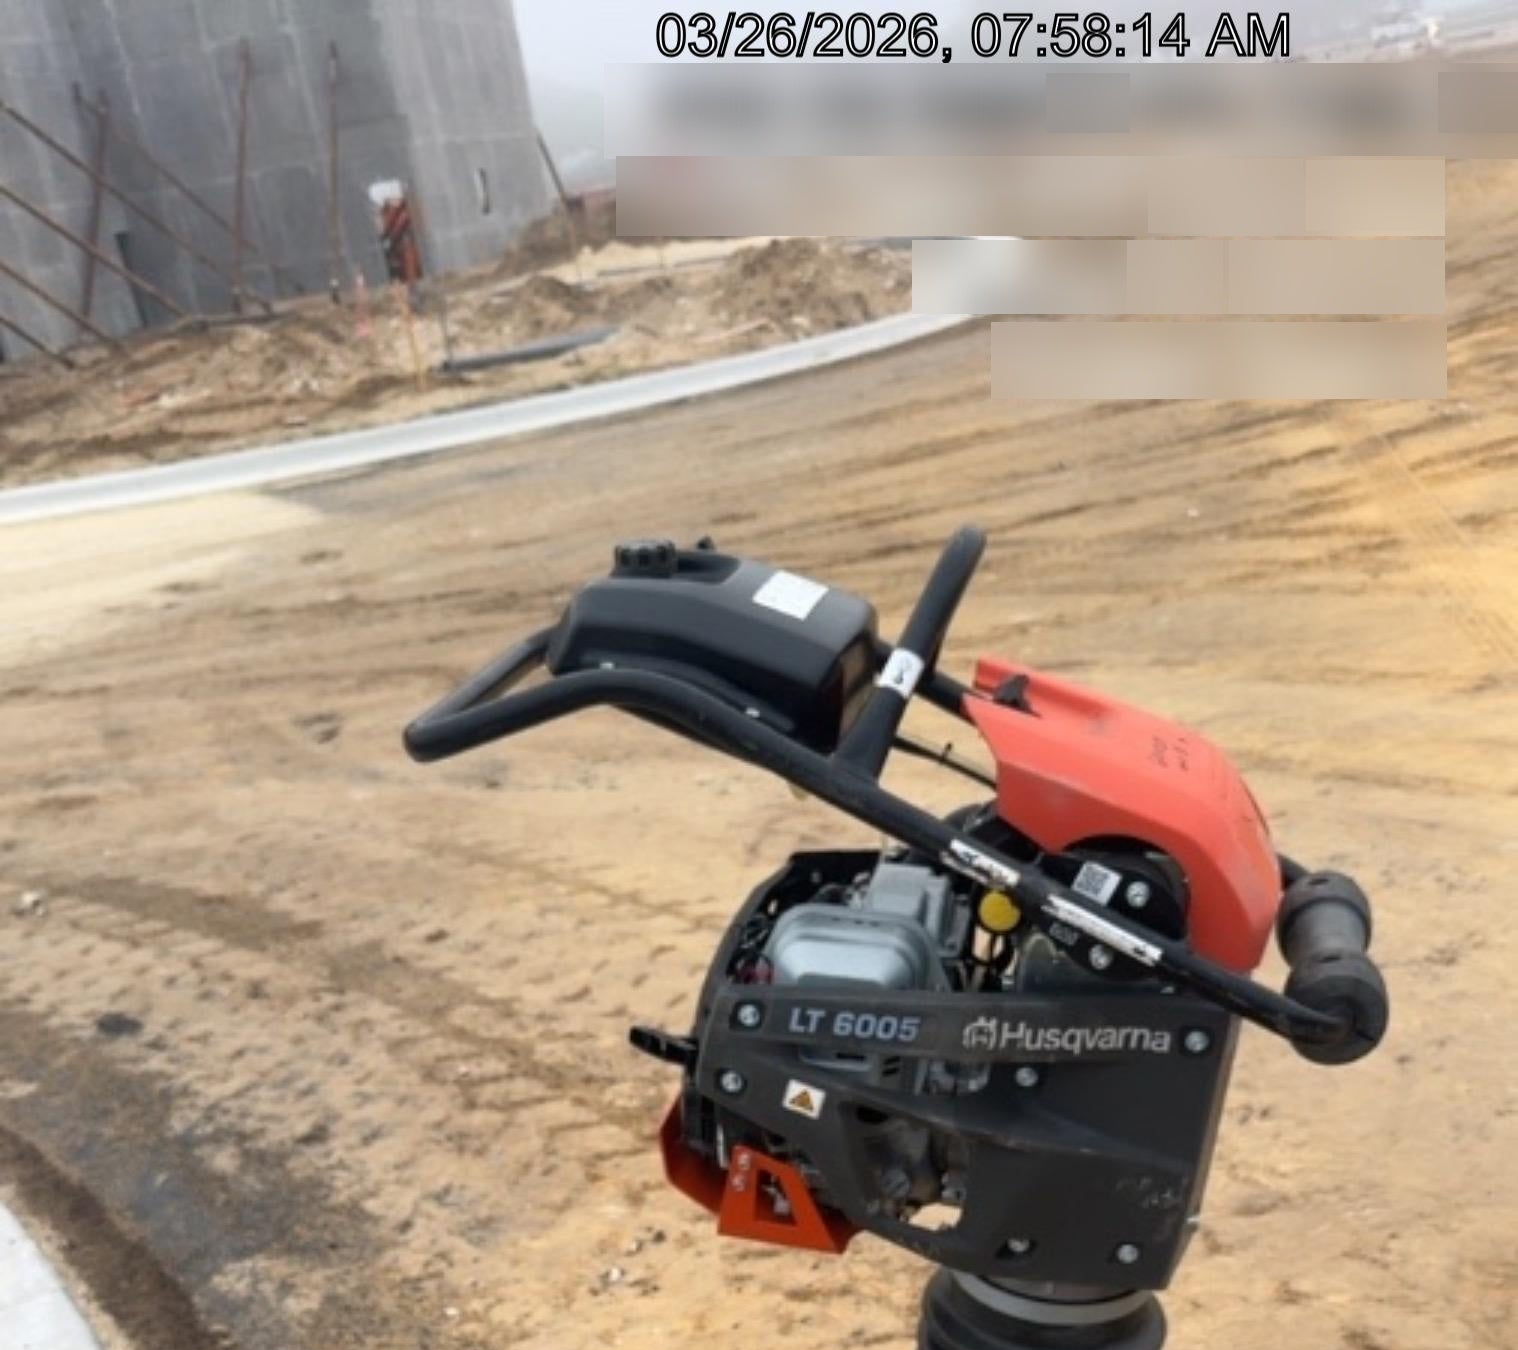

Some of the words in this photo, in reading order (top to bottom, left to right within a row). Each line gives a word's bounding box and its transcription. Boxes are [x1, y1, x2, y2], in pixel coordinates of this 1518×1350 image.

[789, 1006, 825, 1033] LT
[833, 1010, 922, 1042] 6005
[1000, 1021, 1171, 1055] Husqvarna
